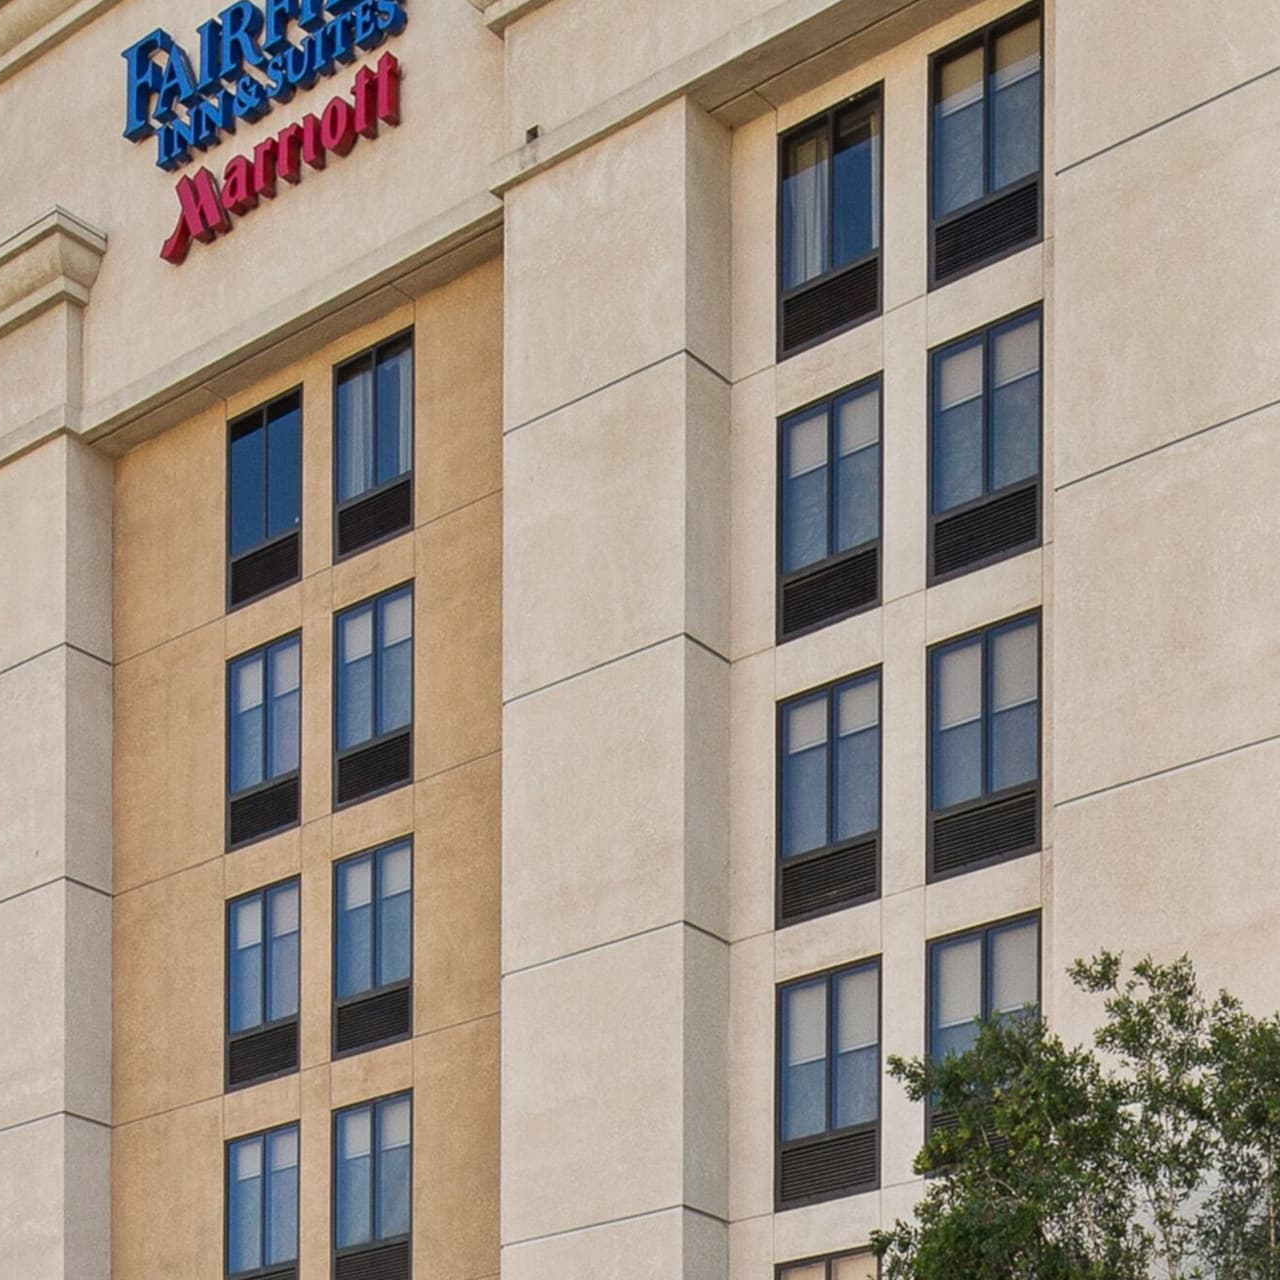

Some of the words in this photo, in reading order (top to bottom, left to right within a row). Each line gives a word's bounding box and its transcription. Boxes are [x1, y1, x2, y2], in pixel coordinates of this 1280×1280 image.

[156, 91, 236, 172] INN
[232, 76, 272, 122] &
[160, 51, 401, 266] Marriott
